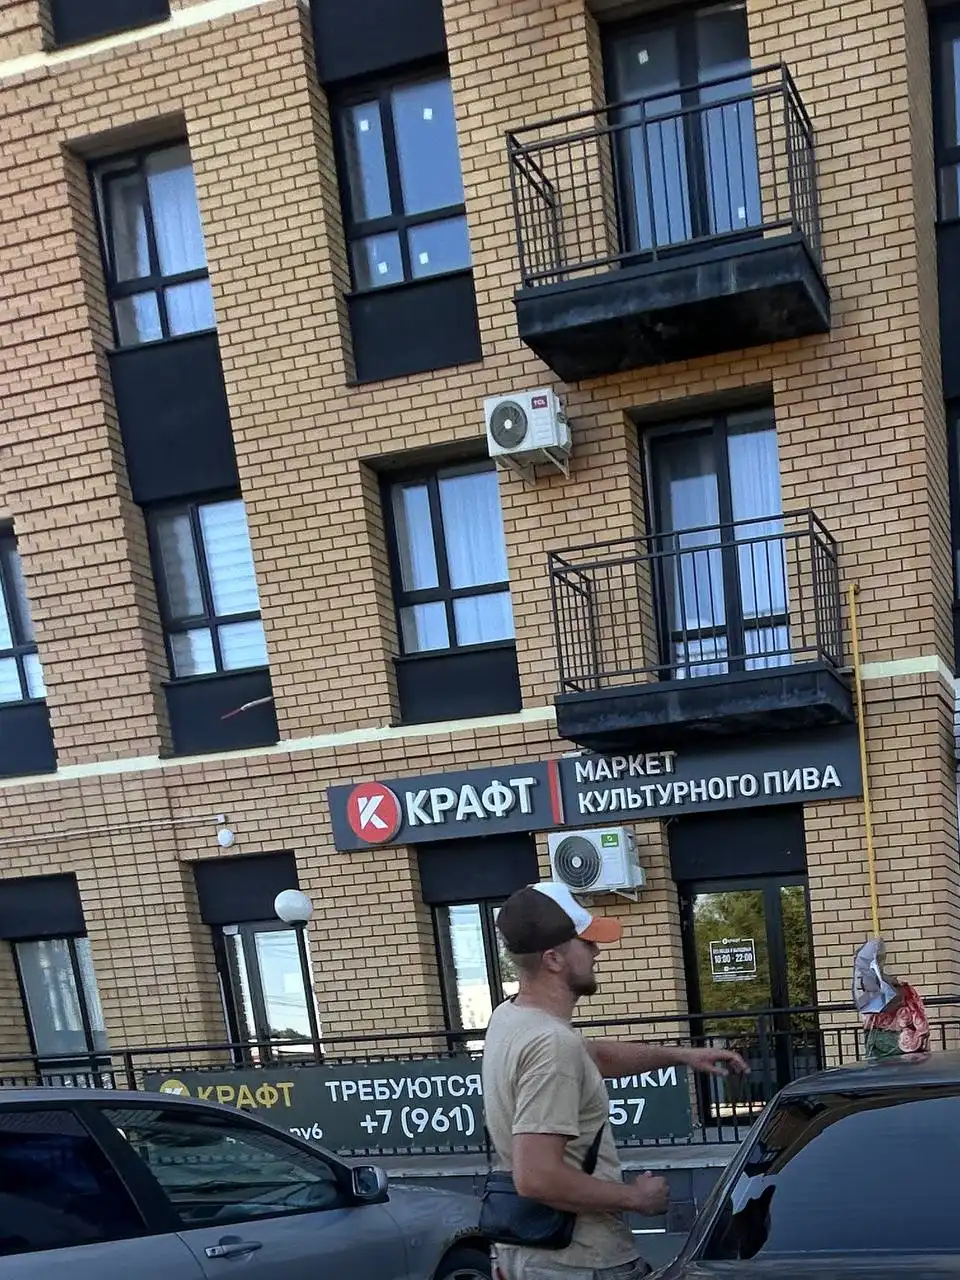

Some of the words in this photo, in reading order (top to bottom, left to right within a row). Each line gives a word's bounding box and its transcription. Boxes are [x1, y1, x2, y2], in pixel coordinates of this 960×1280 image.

[575, 751, 678, 783] МАРКЕТ
[406, 777, 536, 826] КРАФТ
[578, 773, 758, 813] КУЛЬТУРНОГО
[763, 765, 842, 794] ПИВА
[735, 952, 753, 963] 22:00
[197, 1082, 295, 1109] КРАФТ
[325, 1074, 484, 1102] ТРЕБУЮТСЯ
[360, 1109, 392, 1134] +7
[401, 1103, 475, 1138] (961)
